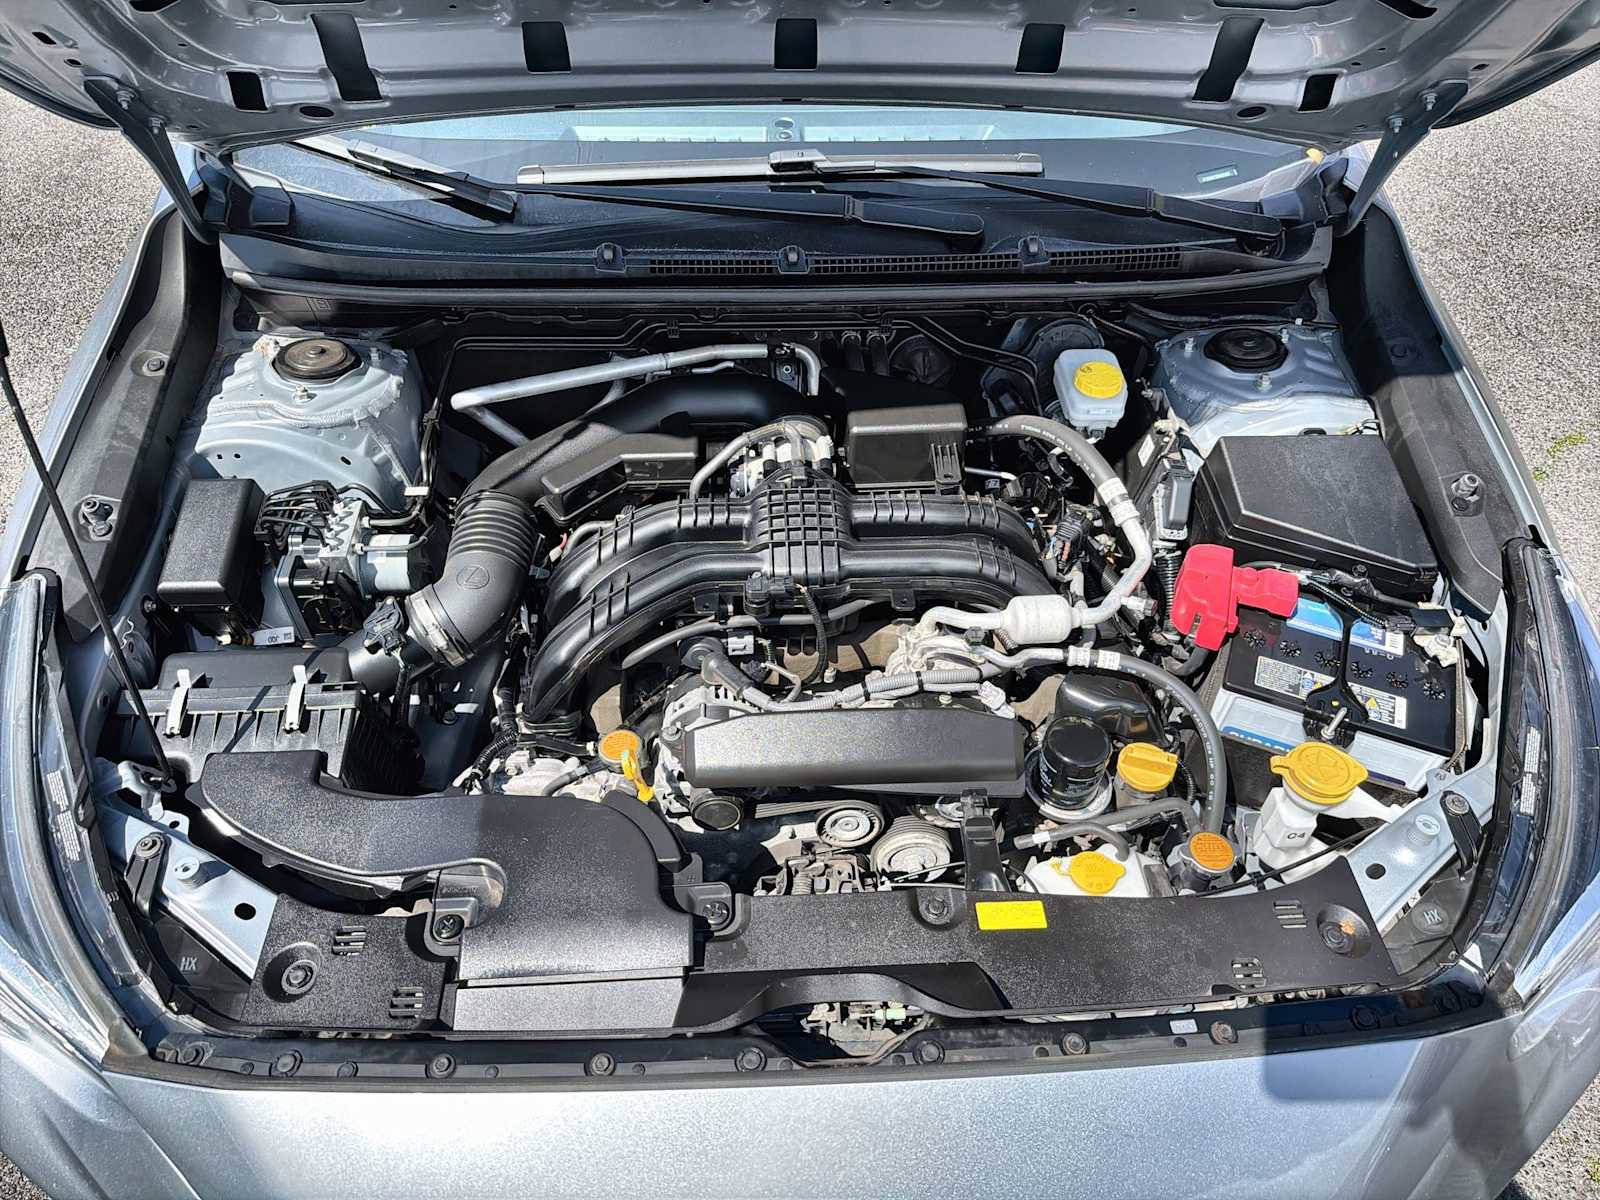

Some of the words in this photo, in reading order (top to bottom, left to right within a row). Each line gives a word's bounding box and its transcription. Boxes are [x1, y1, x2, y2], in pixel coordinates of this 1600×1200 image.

[1287, 832, 1306, 840] C4
[1423, 908, 1442, 925] HX
[180, 956, 198, 971] HX
